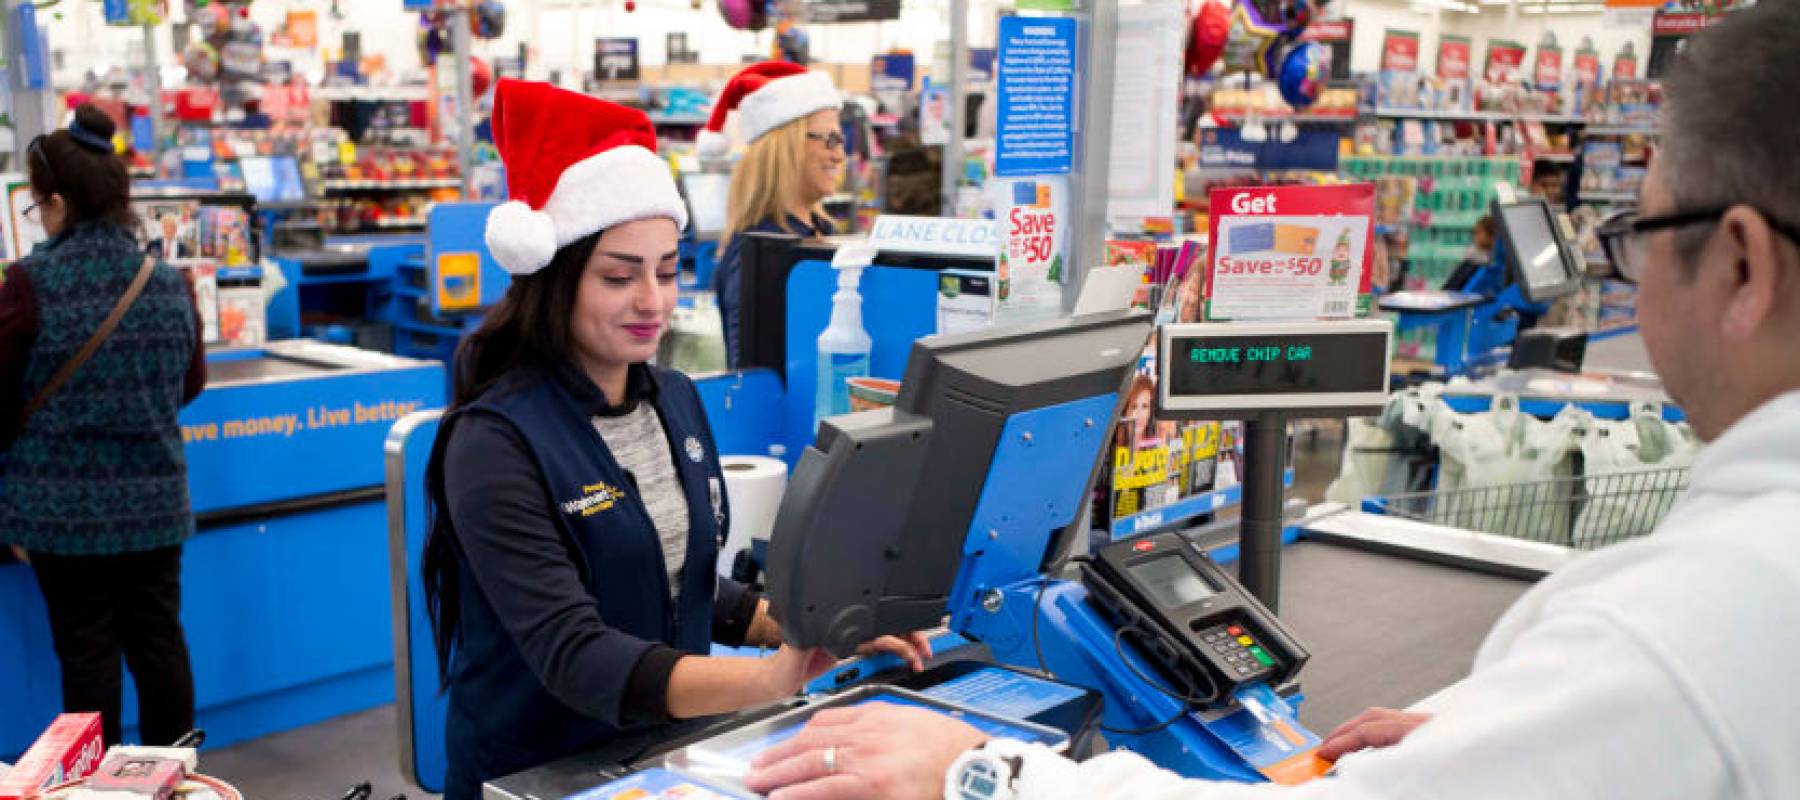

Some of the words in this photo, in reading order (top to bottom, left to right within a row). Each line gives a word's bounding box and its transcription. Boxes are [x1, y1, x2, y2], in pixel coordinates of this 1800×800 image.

[1231, 192, 1278, 214] Get
[874, 223, 935, 241] LANE
[1009, 207, 1056, 236] Save
[1022, 235, 1052, 263] $50
[1216, 255, 1273, 275] Save
[1286, 256, 1323, 276] $50
[1190, 348, 1241, 363] REMOVE
[1247, 346, 1281, 361] CHIP
[1287, 345, 1313, 361] CAR
[223, 413, 303, 437] money.
[307, 404, 349, 429] Live
